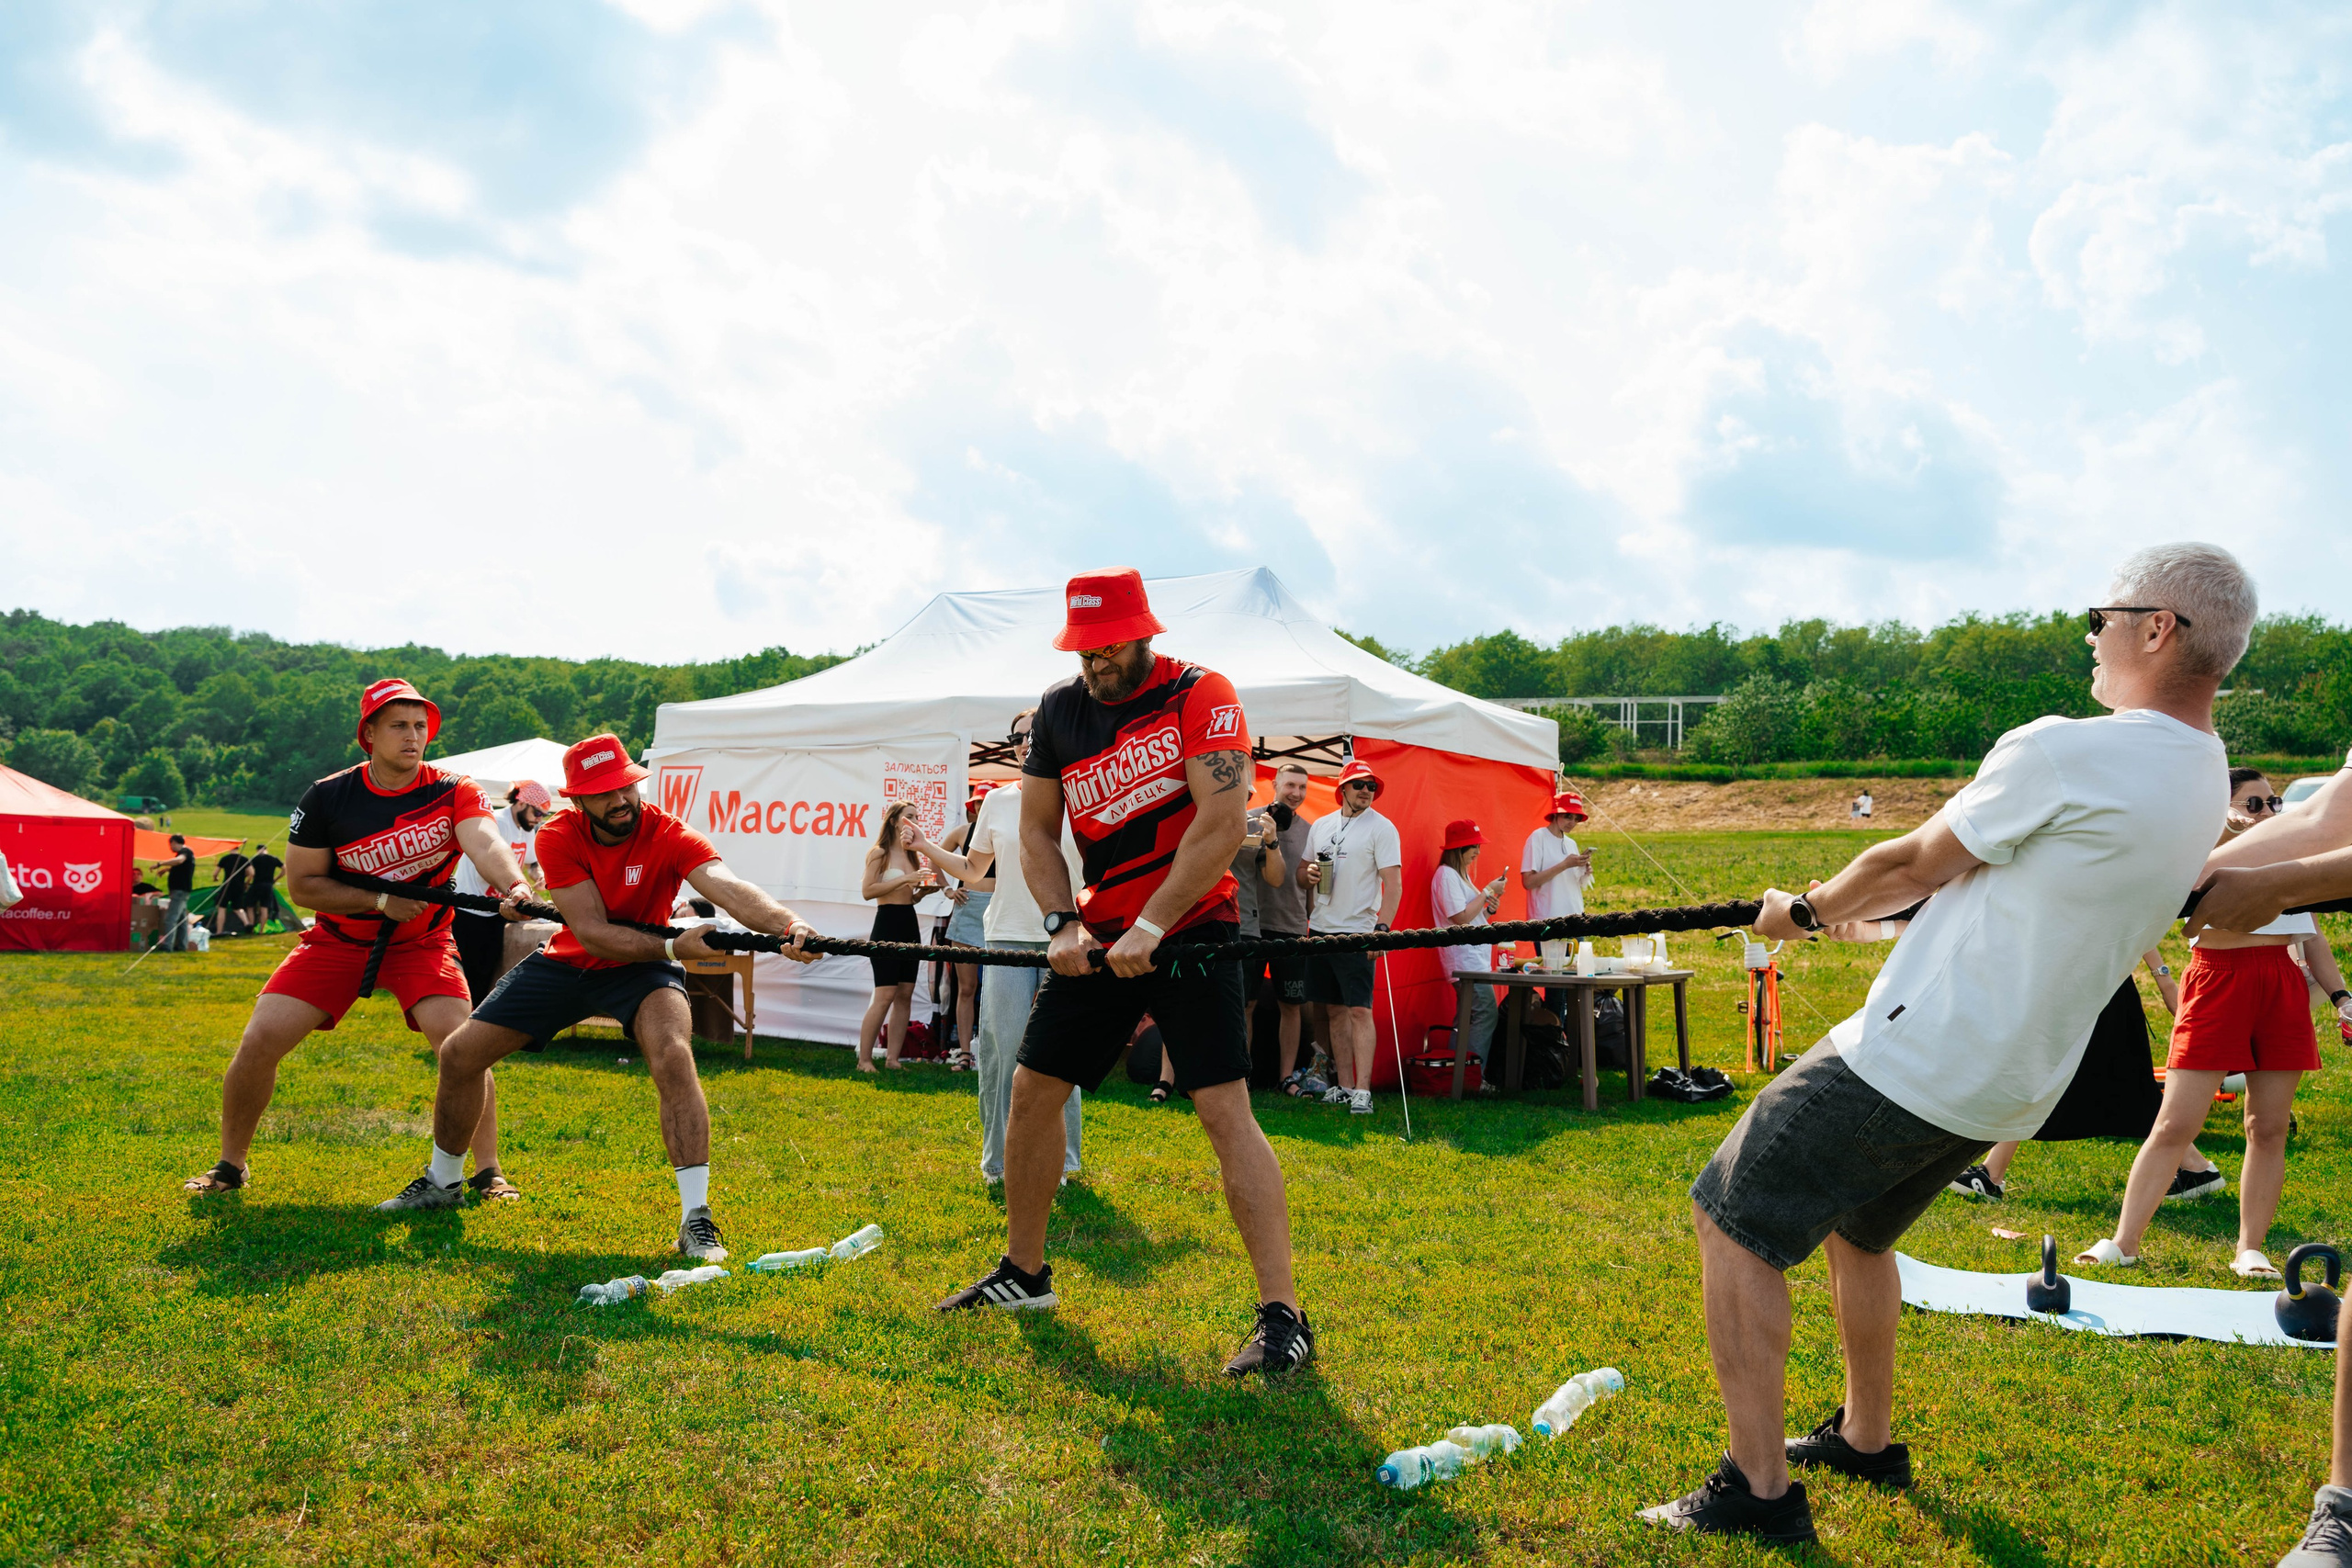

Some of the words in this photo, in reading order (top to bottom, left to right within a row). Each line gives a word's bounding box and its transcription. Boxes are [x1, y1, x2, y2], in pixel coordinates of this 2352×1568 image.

[1083, 596, 1102, 606] Class
[1212, 707, 1241, 733] W
[582, 755, 599, 769] World
[599, 751, 616, 762] Class
[884, 761, 948, 774] ЗАПИСАТЬСЯ
[1063, 759, 1120, 813] World
[1117, 731, 1181, 784] Class
[663, 773, 695, 819] W
[1110, 782, 1168, 819] ЛИПЕЦК
[708, 790, 869, 838] Массаж
[340, 838, 401, 874] World
[399, 817, 453, 858] Class
[391, 854, 441, 881] ЛИПЕЦК
[628, 866, 641, 884] W
